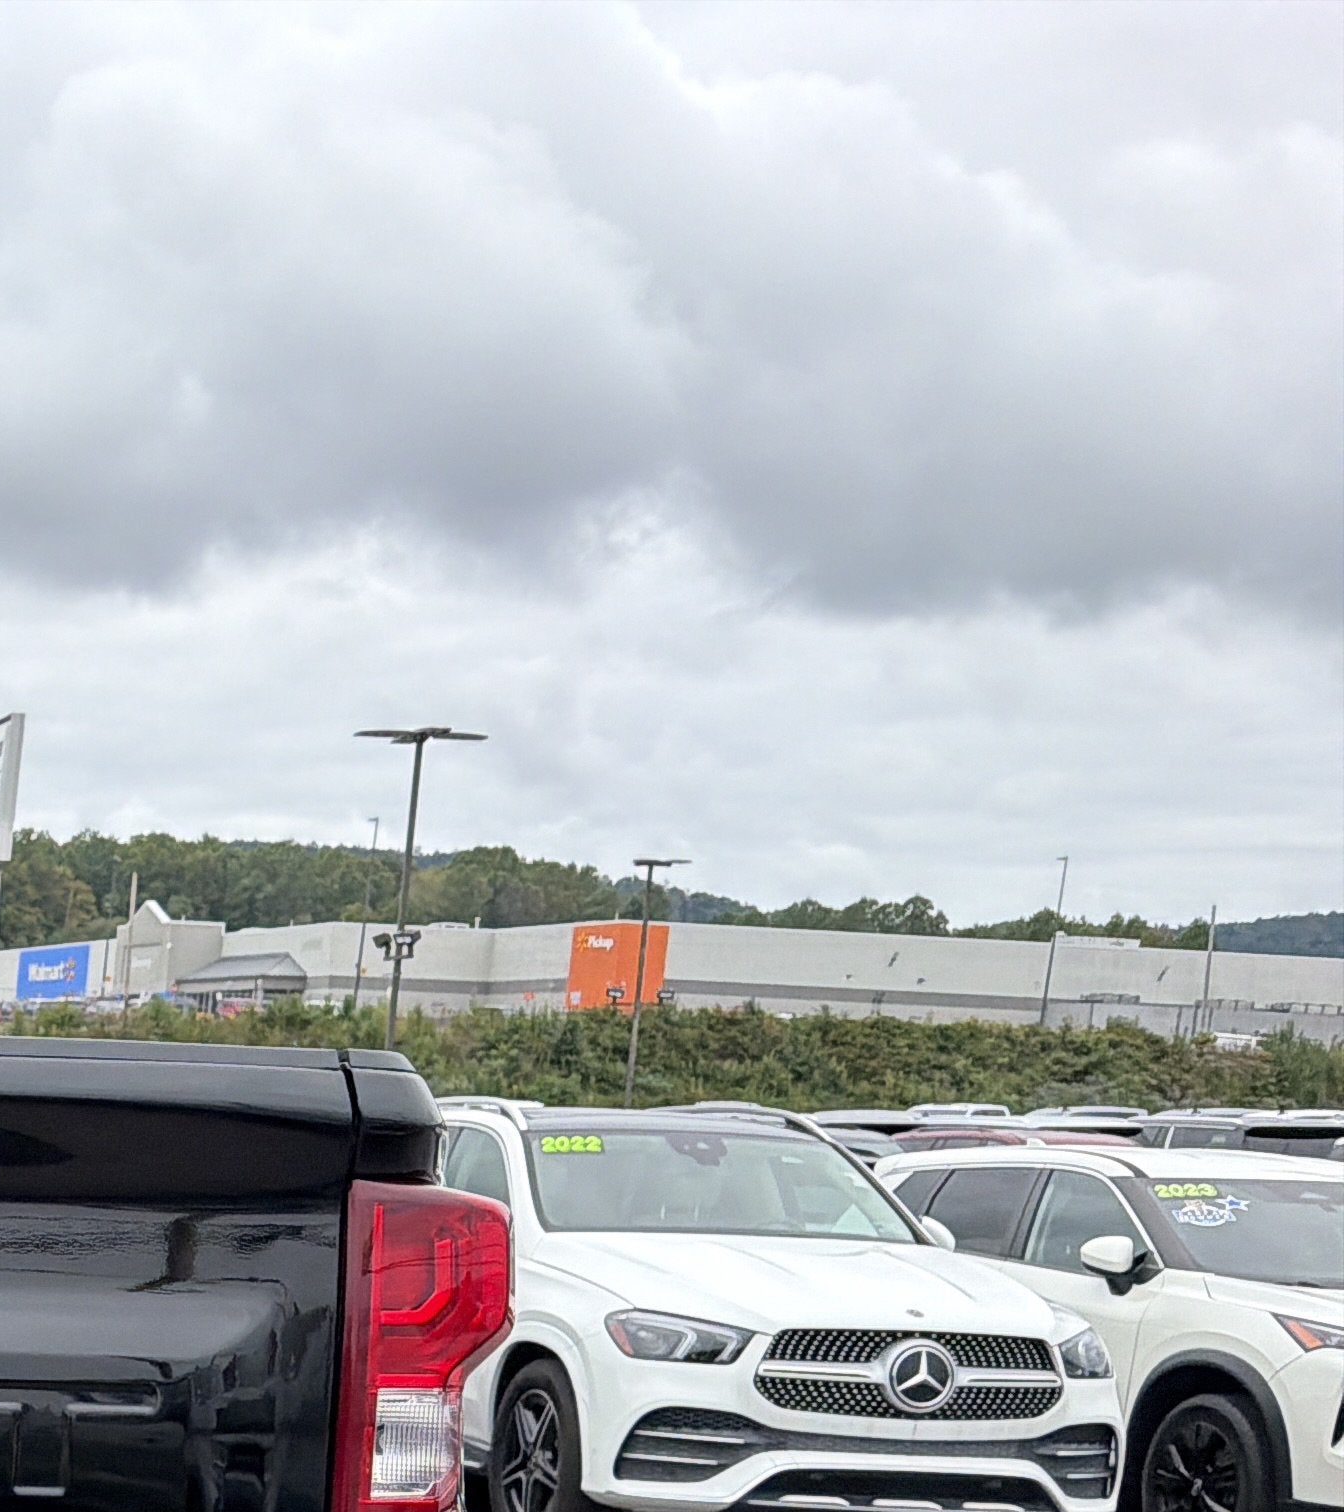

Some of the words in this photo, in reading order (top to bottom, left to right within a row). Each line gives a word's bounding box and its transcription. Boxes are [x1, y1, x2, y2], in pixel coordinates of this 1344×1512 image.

[587, 934, 614, 951] Pickup
[28, 961, 66, 982] Walmart
[541, 1135, 602, 1153] 2022
[1154, 1183, 1218, 1198] 2023
